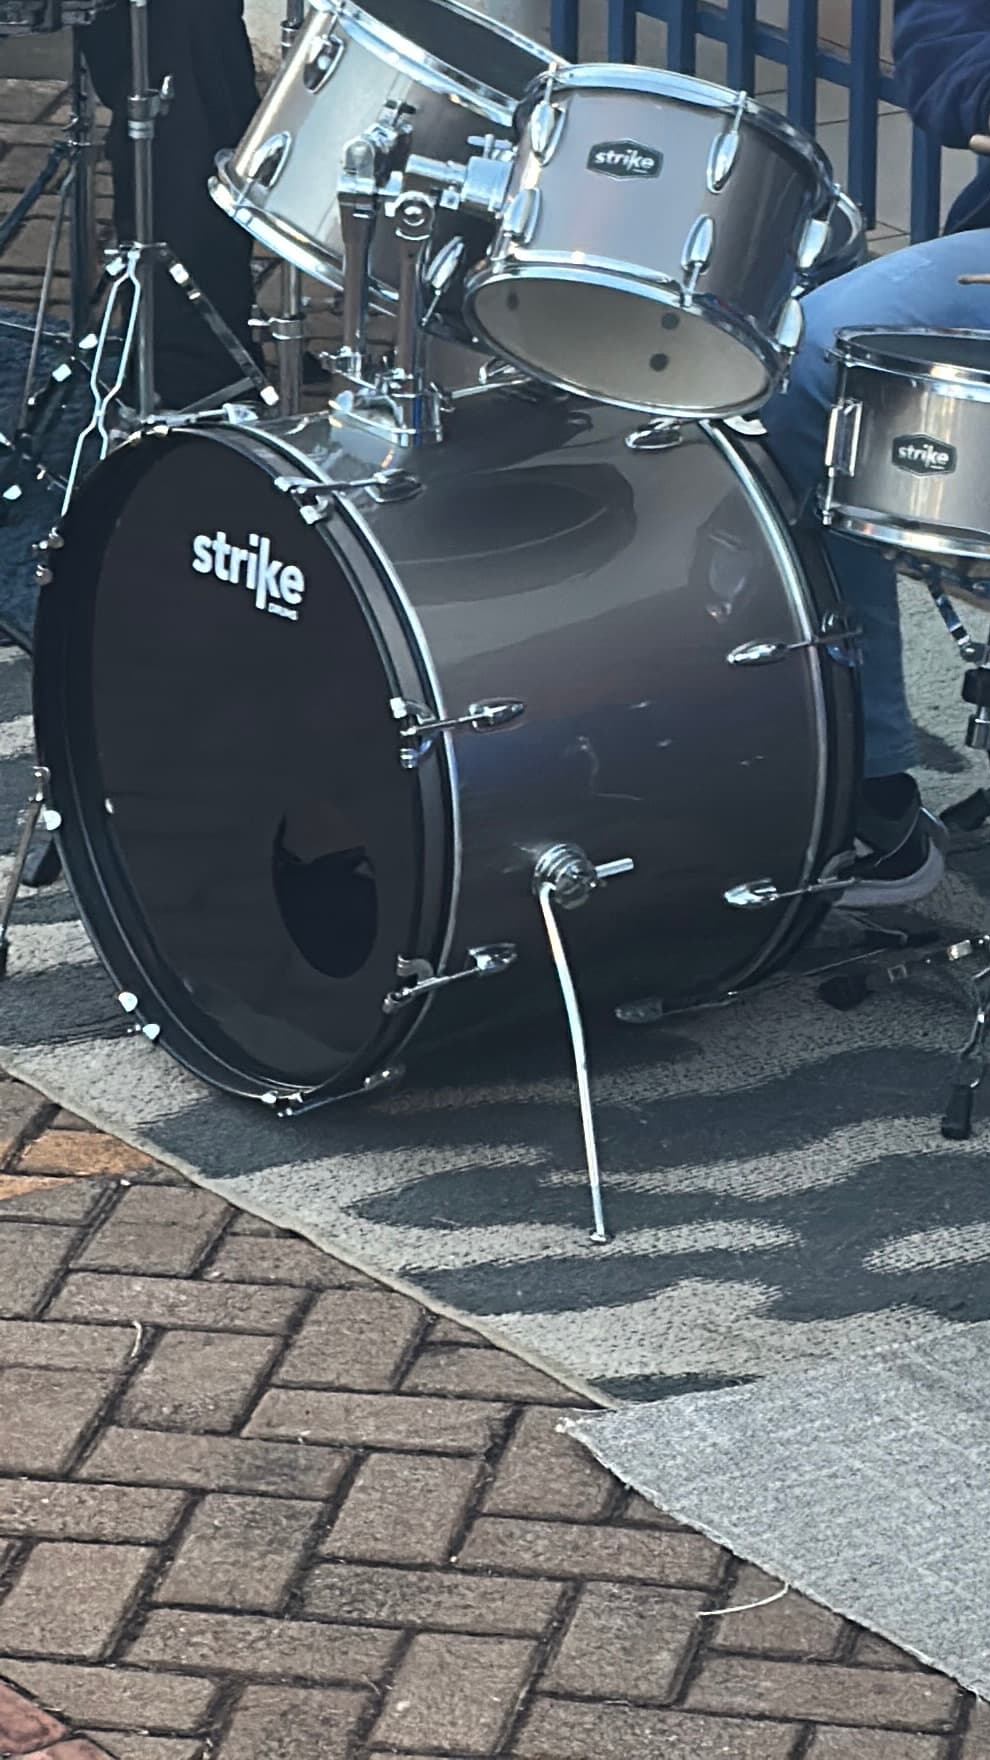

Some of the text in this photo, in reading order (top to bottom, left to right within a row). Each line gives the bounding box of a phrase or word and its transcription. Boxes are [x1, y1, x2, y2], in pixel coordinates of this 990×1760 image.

[595, 148, 655, 171] strike
[898, 443, 949, 469] strike
[192, 531, 305, 610] strike
